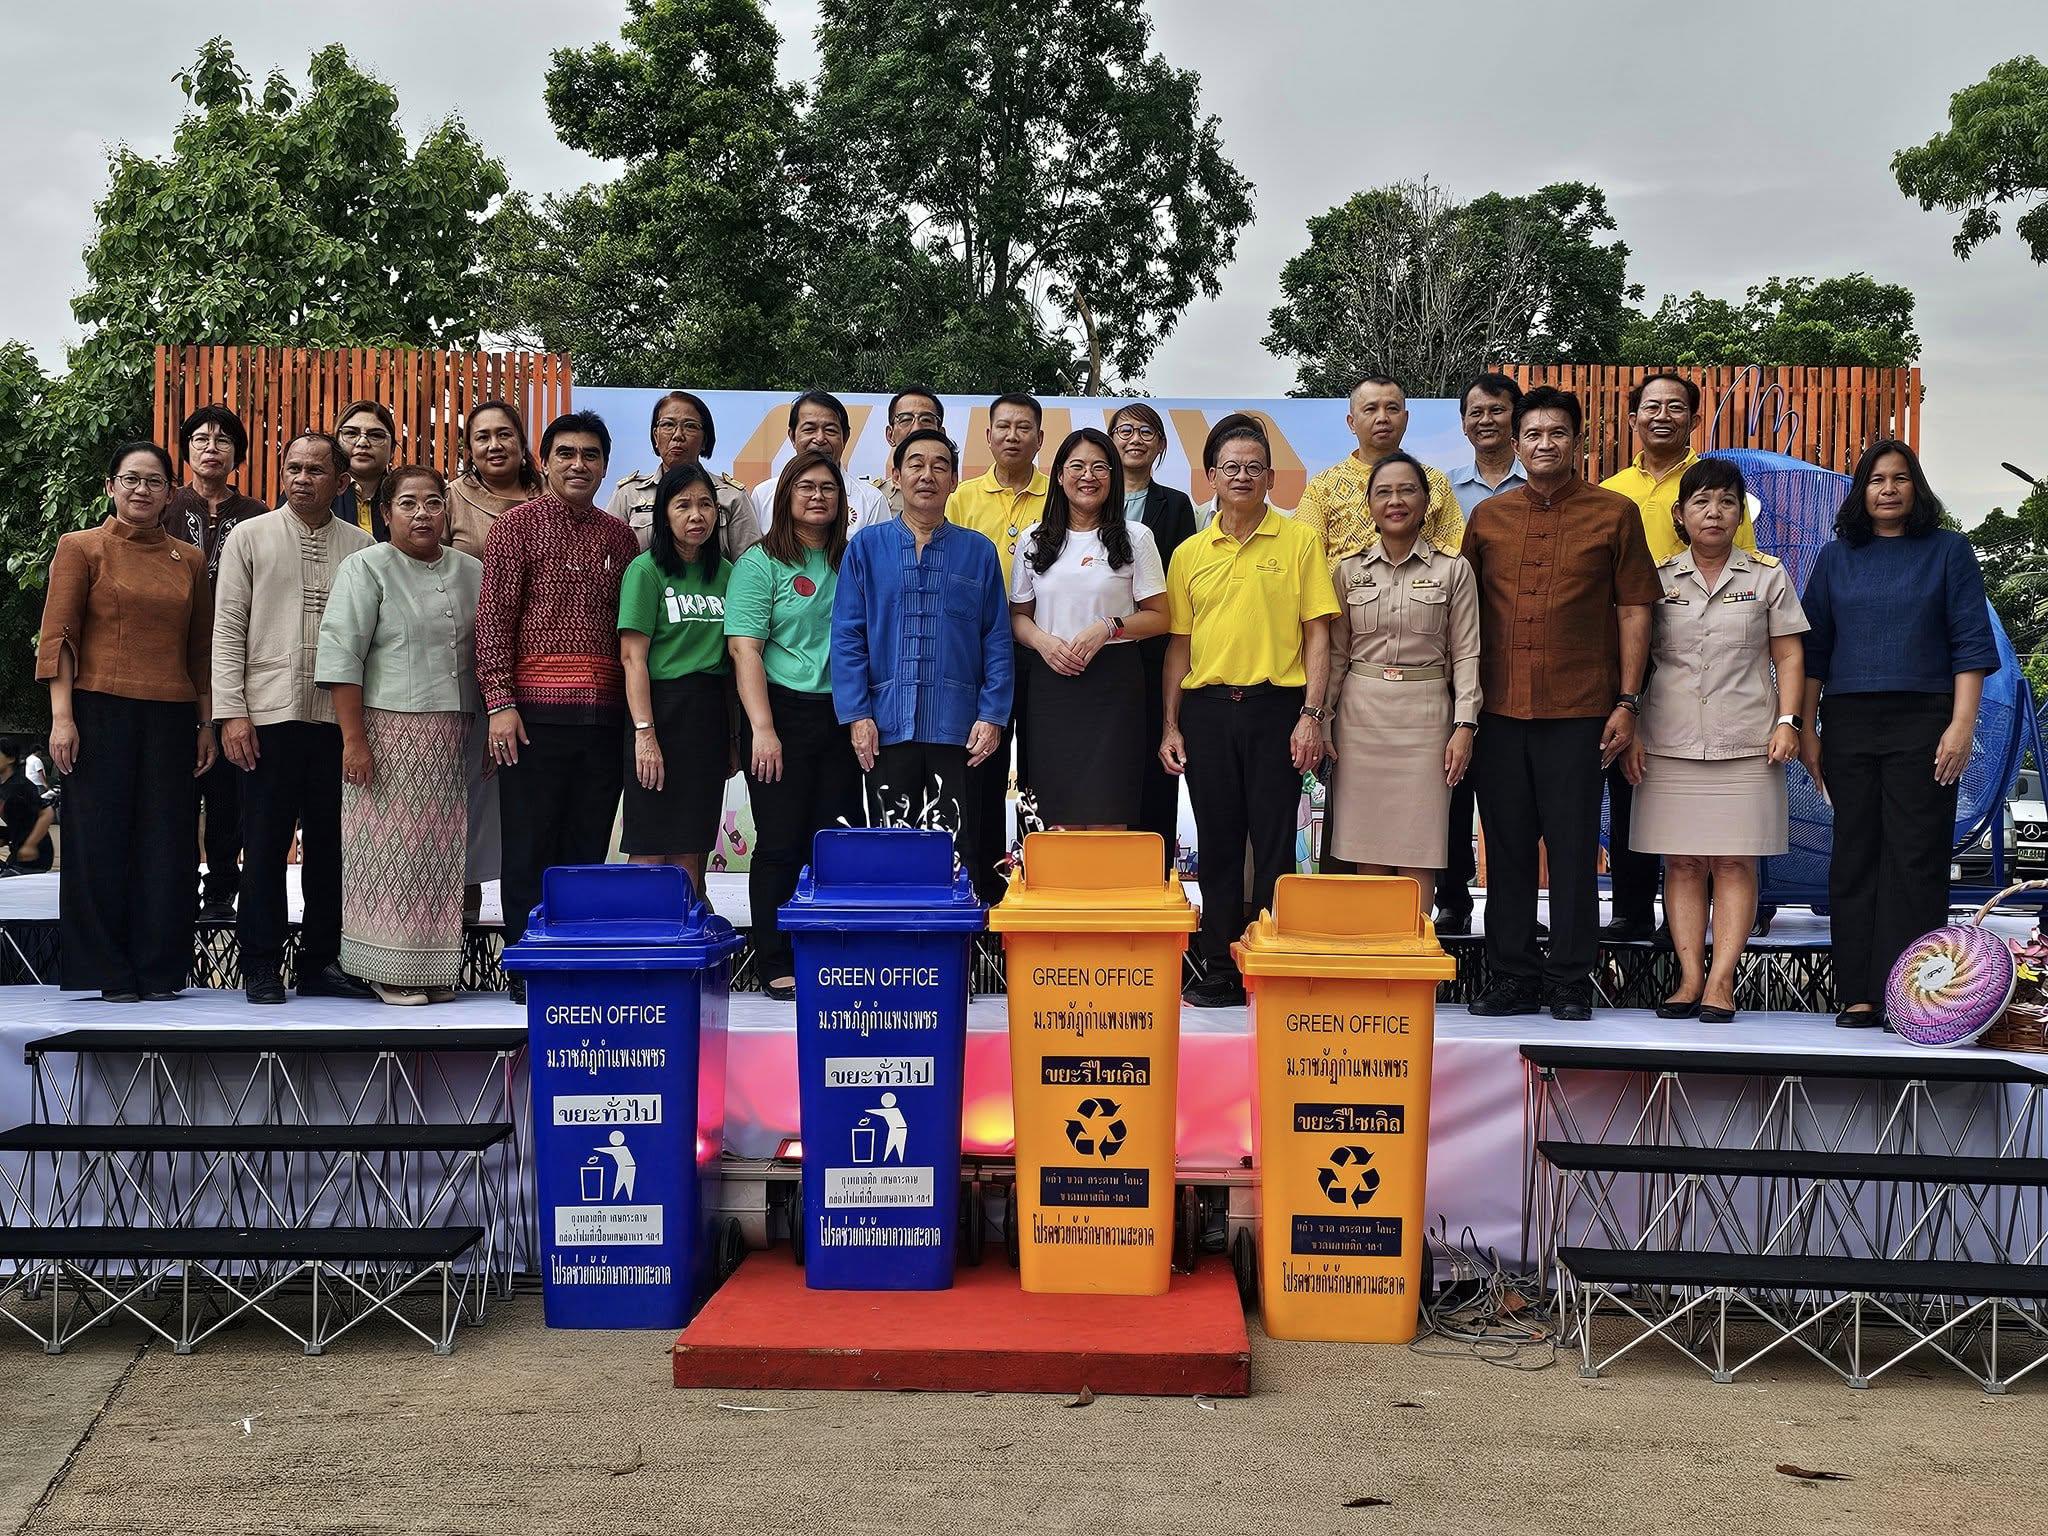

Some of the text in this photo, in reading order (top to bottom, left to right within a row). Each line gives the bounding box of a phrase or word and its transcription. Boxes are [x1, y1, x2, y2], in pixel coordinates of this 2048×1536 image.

[664, 586, 725, 624] iKPR
[818, 967, 939, 987] GREEN OFFICE
[1032, 967, 1154, 987] GREEN OFFICE
[545, 1005, 666, 1025] GREEN OFFICE
[818, 1000, 938, 1038] ม.ราชภัฏกำแพงเพชร
[1033, 1001, 1154, 1038] ม.ราชภัฏกำแพงเพชร
[1286, 1013, 1410, 1035] GREEN OFFICE
[546, 1038, 666, 1075] ม.ราชภัฏกำแพงเพชร
[830, 1059, 930, 1084] ขยะทั่วไป
[1045, 1060, 1147, 1084] ขยะรีไซเคิล
[1286, 1047, 1409, 1085] ม.ราชภัฏกำแพงเพชร
[558, 1097, 657, 1123] ขยะทั่วไป
[1297, 1108, 1401, 1132] ขยะรีไซเคิล
[819, 1215, 941, 1247] โปรดช่วยกันรักษาความสะอาด
[1032, 1214, 1155, 1247] โปรดช่วยกันรักษาความสะอาด
[550, 1254, 671, 1285] โปรดช่วยกันรักษาความสะอาด
[1282, 1262, 1405, 1296] โปรดช่วยกันรักษาความสะอาด
